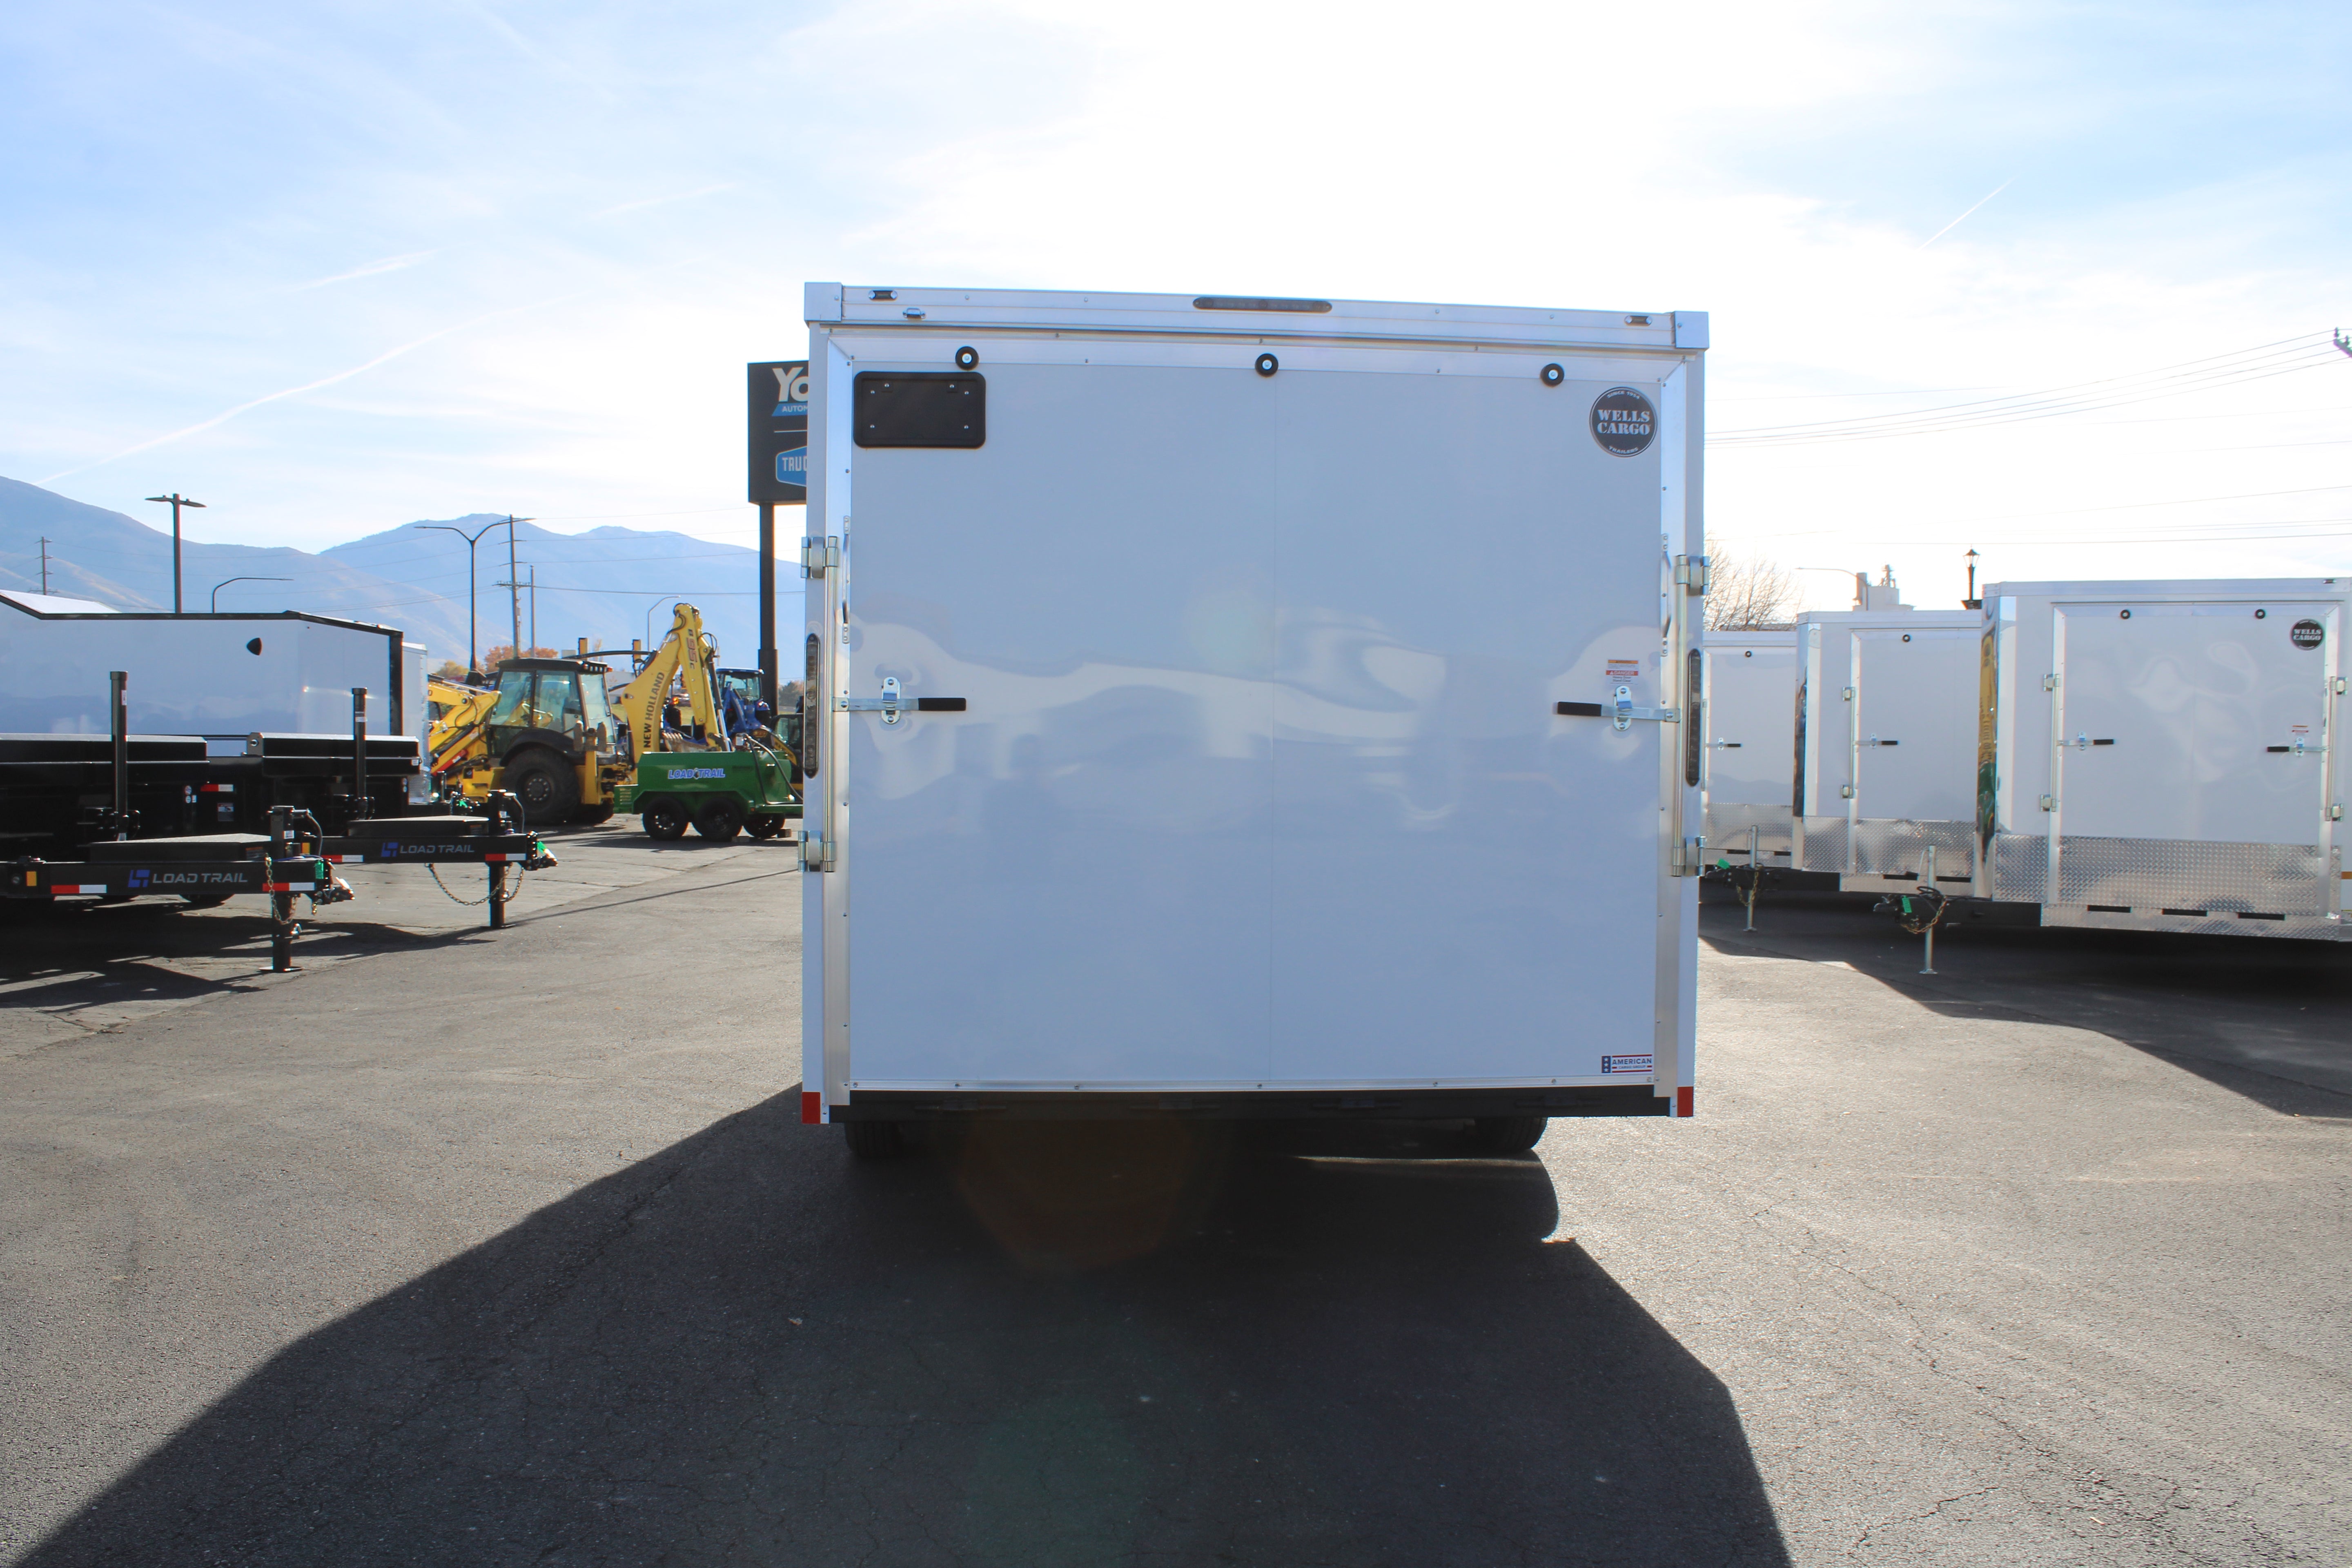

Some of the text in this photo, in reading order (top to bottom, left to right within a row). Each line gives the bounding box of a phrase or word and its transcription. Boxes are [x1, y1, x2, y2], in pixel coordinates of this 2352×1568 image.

[1597, 409, 1650, 422] WELLS
[1597, 422, 1650, 435] CARGO
[1608, 445, 1638, 454] TRAILERS
[645, 672, 665, 721] HOLLAND
[668, 768, 725, 779] LOAD TRAIL
[438, 845, 474, 853] TRAIL
[153, 873, 248, 883] LOAD TRAIL
